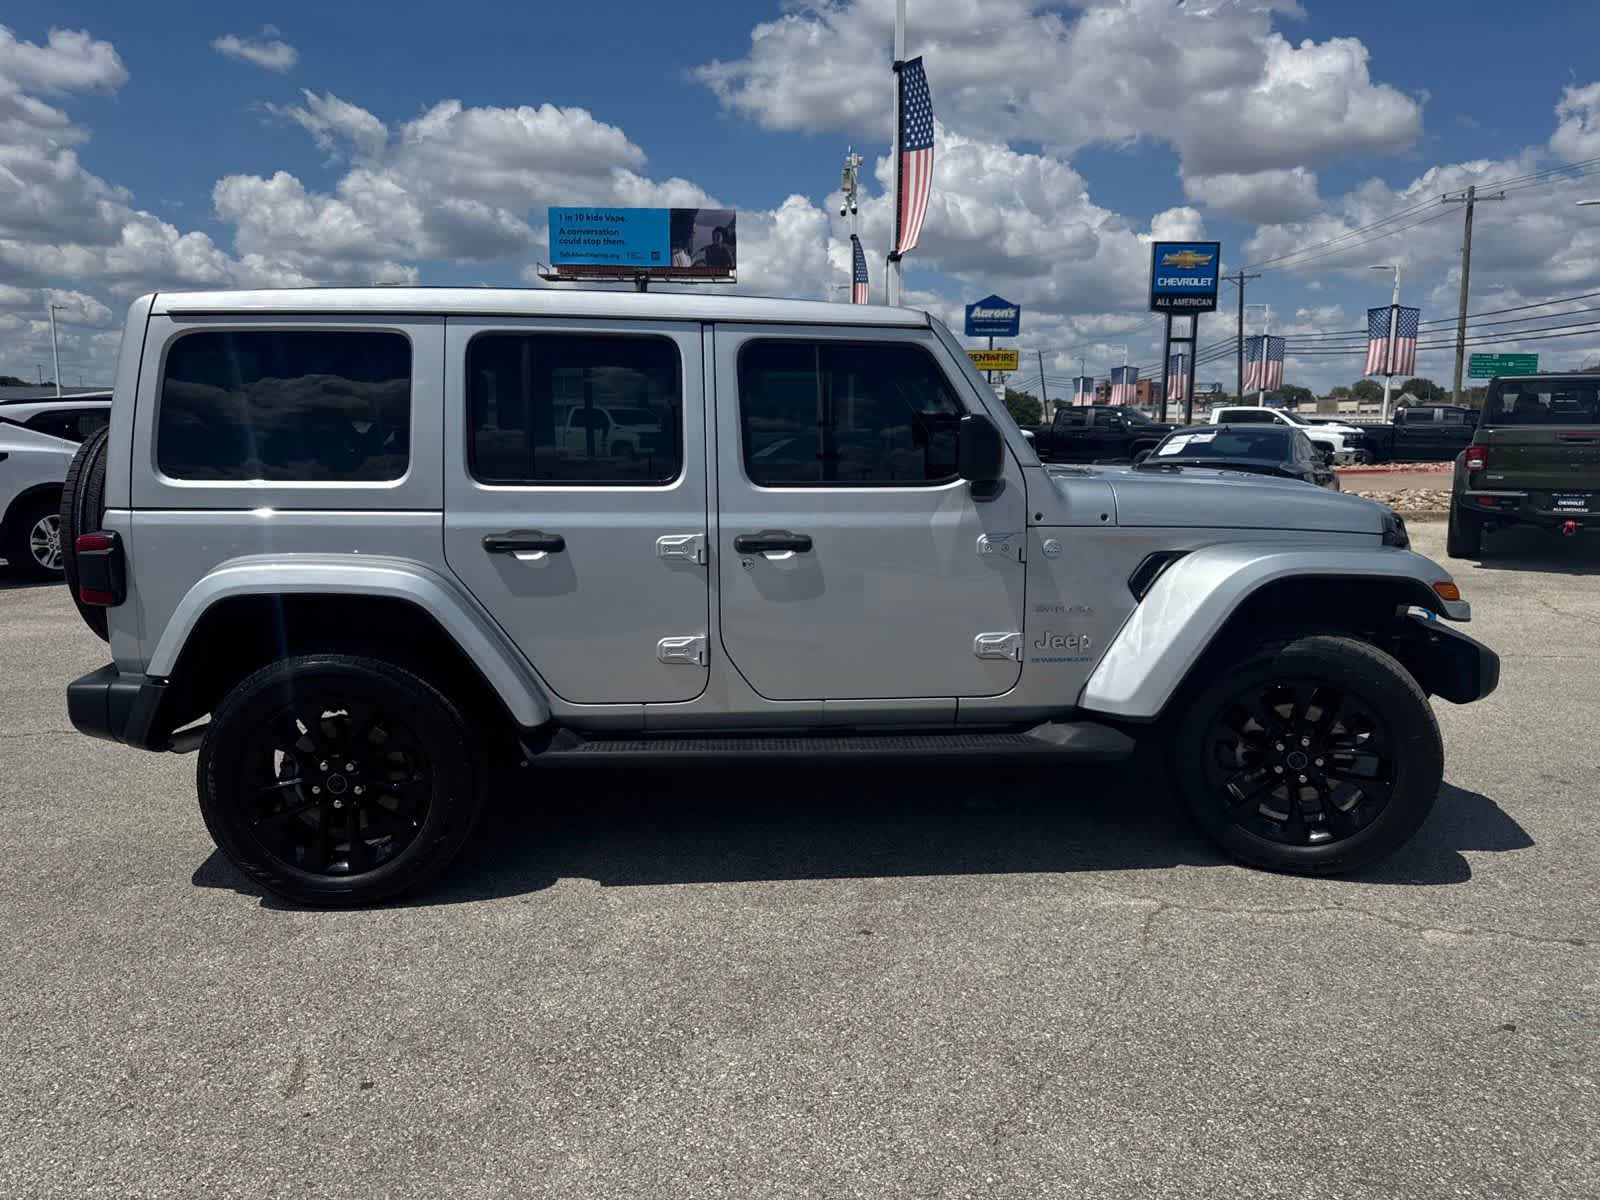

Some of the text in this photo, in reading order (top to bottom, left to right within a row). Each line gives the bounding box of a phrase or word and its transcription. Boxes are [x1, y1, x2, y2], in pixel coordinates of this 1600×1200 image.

[564, 213, 573, 221] in
[575, 213, 584, 221] 10
[585, 213, 604, 221] kids
[559, 227, 620, 236] A conversation
[559, 237, 582, 245] could
[583, 237, 602, 247] stop
[1157, 277, 1213, 287] CHEVROLET
[1156, 298, 1213, 306] ALL AMERICAN
[970, 306, 1017, 319] Aaron's
[1033, 631, 1092, 655] Jeep
